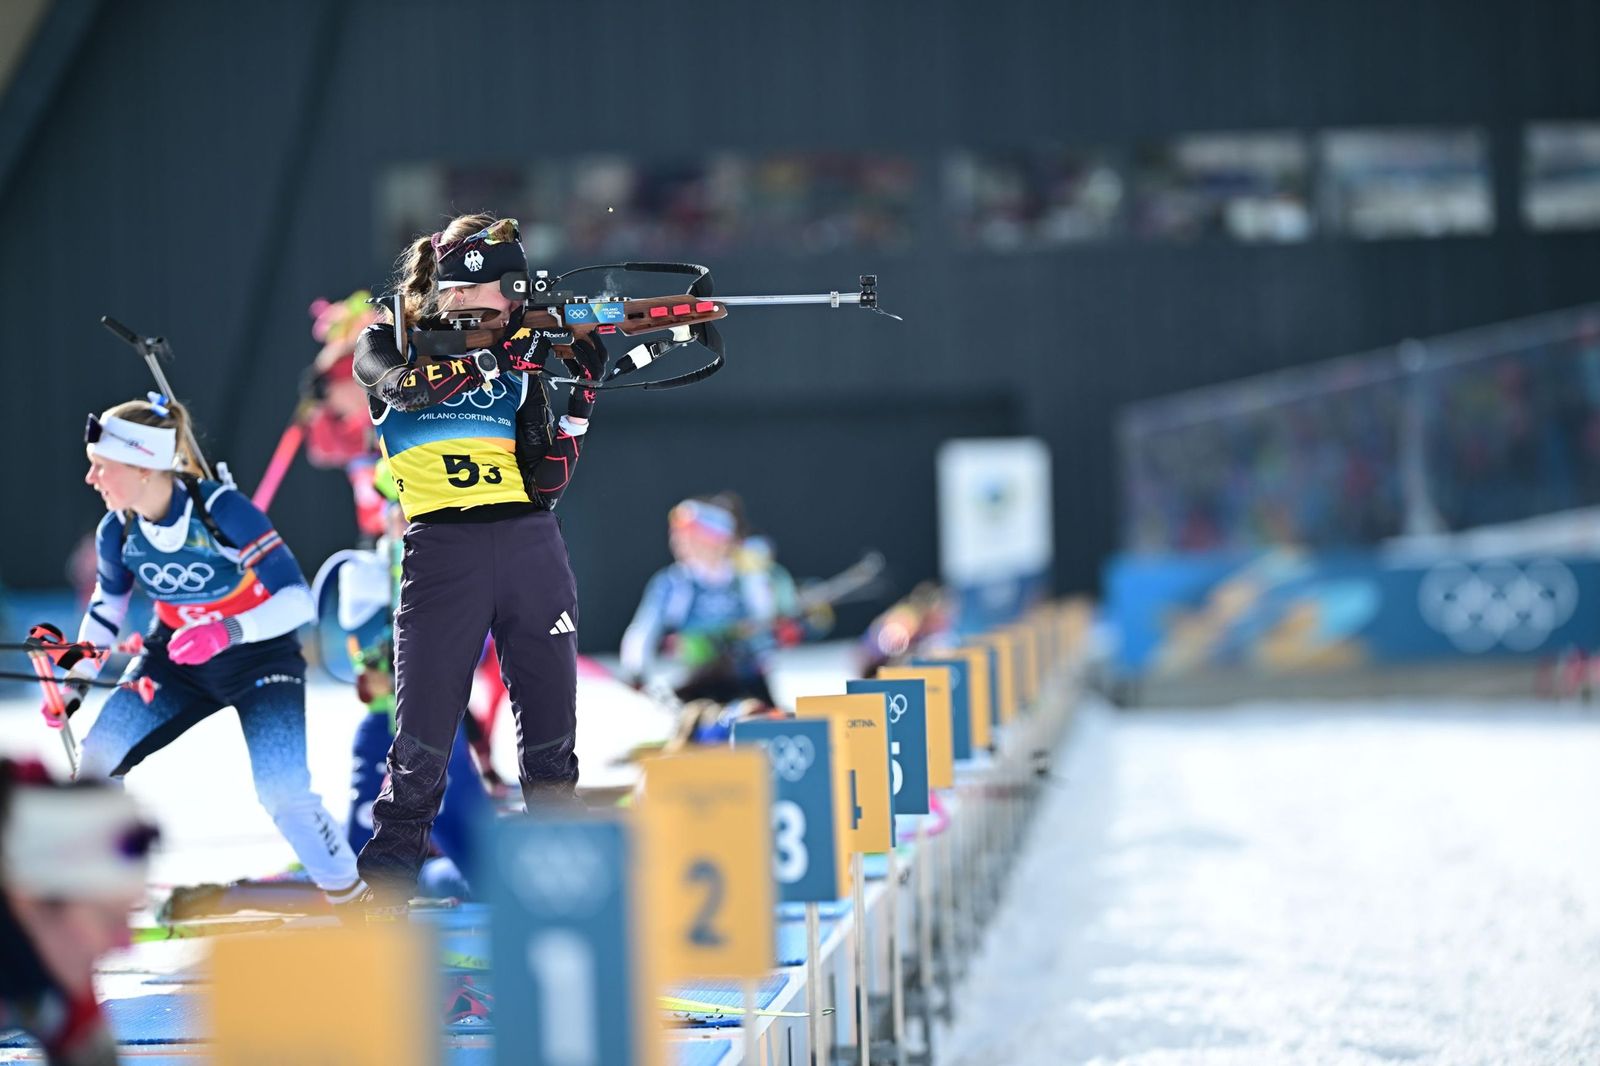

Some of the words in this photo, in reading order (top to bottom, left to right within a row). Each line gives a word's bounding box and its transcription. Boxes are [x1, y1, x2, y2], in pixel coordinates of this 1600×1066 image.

[417, 413, 457, 421] MILANO
[458, 413, 497, 423] CORTINA
[498, 417, 512, 427] 2026
[441, 454, 480, 488] 5
[481, 463, 503, 485] 3
[772, 799, 809, 884] 3
[684, 859, 728, 948] 2
[526, 929, 599, 1066] 1
